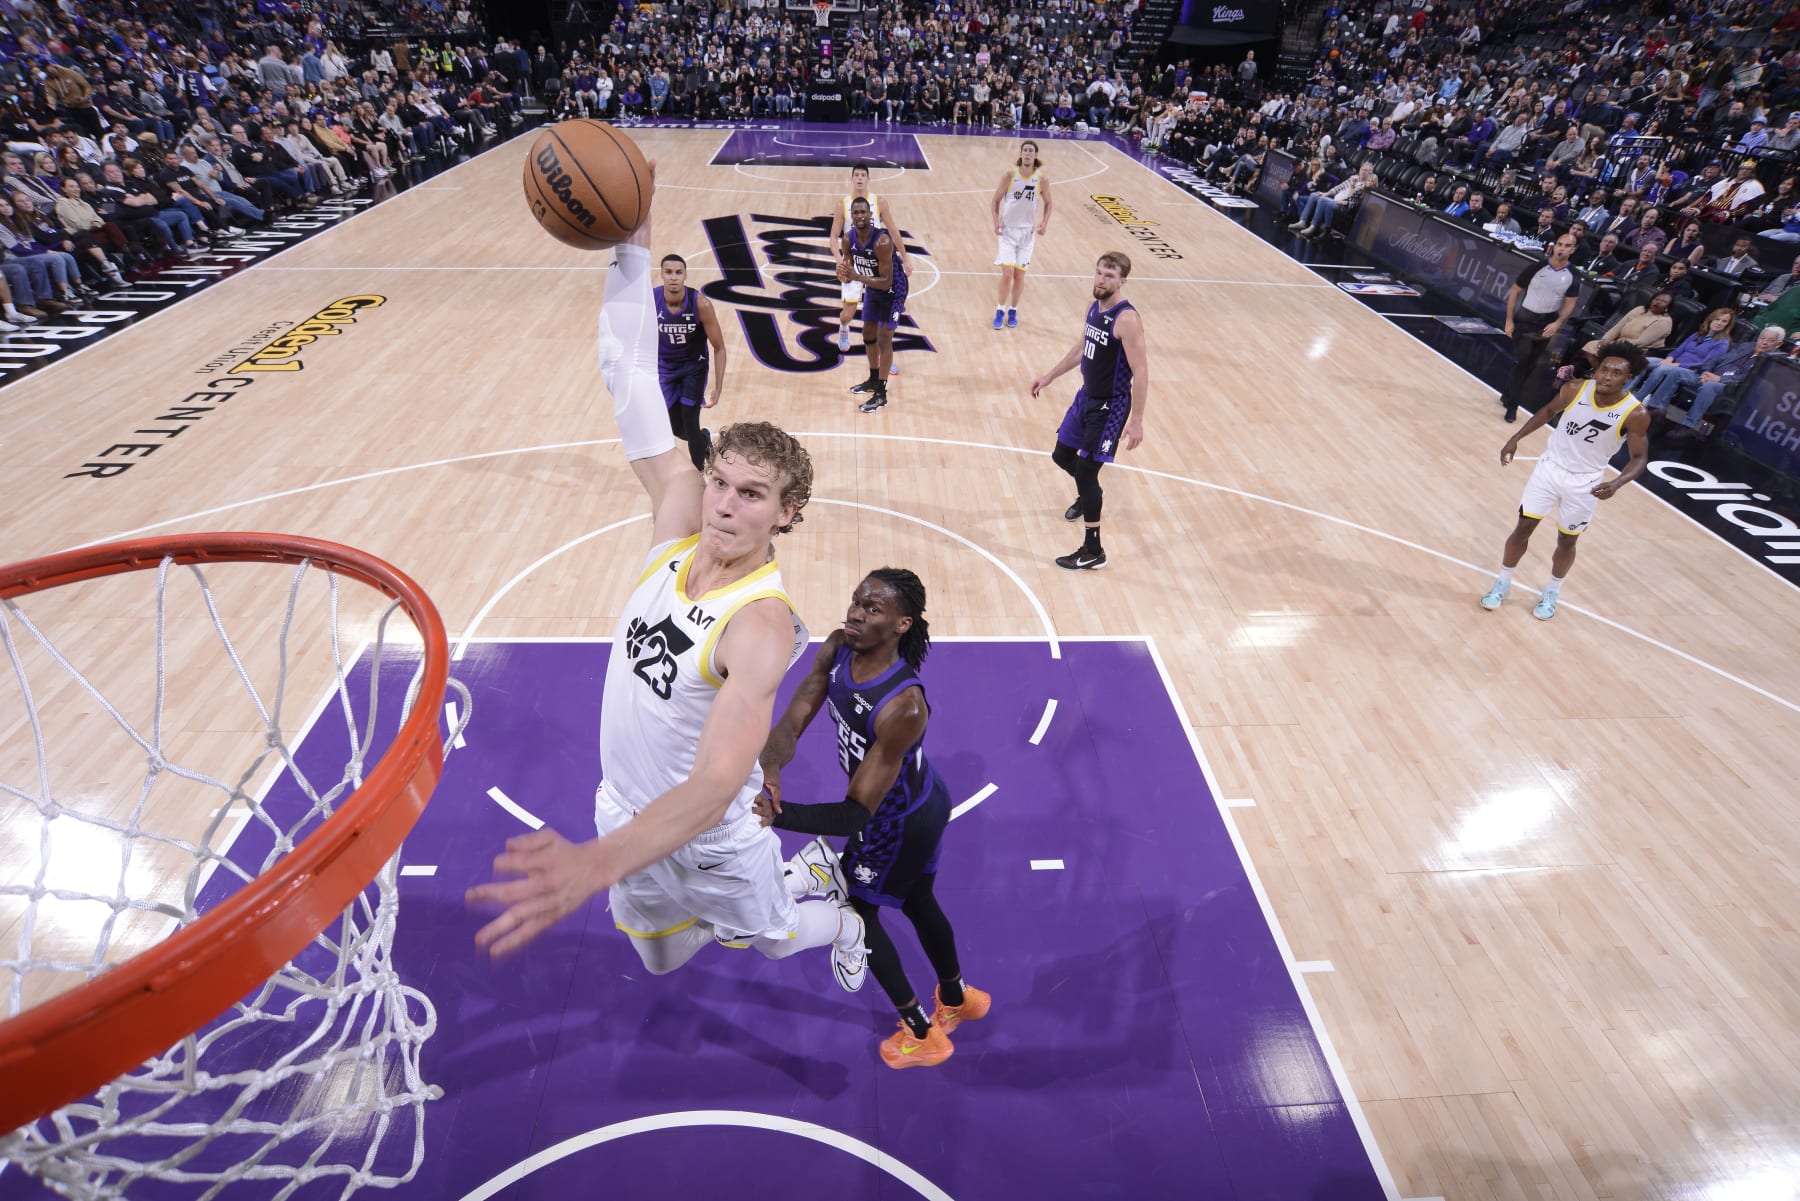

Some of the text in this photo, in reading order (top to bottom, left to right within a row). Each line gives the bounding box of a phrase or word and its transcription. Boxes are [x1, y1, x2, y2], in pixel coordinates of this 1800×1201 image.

[1212, 5, 1245, 23] Kings
[811, 93, 835, 101] dialpad
[536, 143, 597, 229] Wilson
[1025, 191, 1035, 201] 41
[98, 198, 374, 302] SACRAMENTO
[1124, 226, 1184, 259] CENTER
[1388, 225, 1444, 263] Michelob
[658, 323, 697, 334] KINGS
[667, 333, 687, 344] 13
[194, 320, 294, 374] Credit Union
[1083, 339, 1096, 361] 10
[62, 377, 254, 478] CENTER
[1583, 428, 1600, 443] 2
[686, 605, 716, 631] LVT
[633, 635, 678, 700] 23
[853, 692, 874, 712] dialpad
